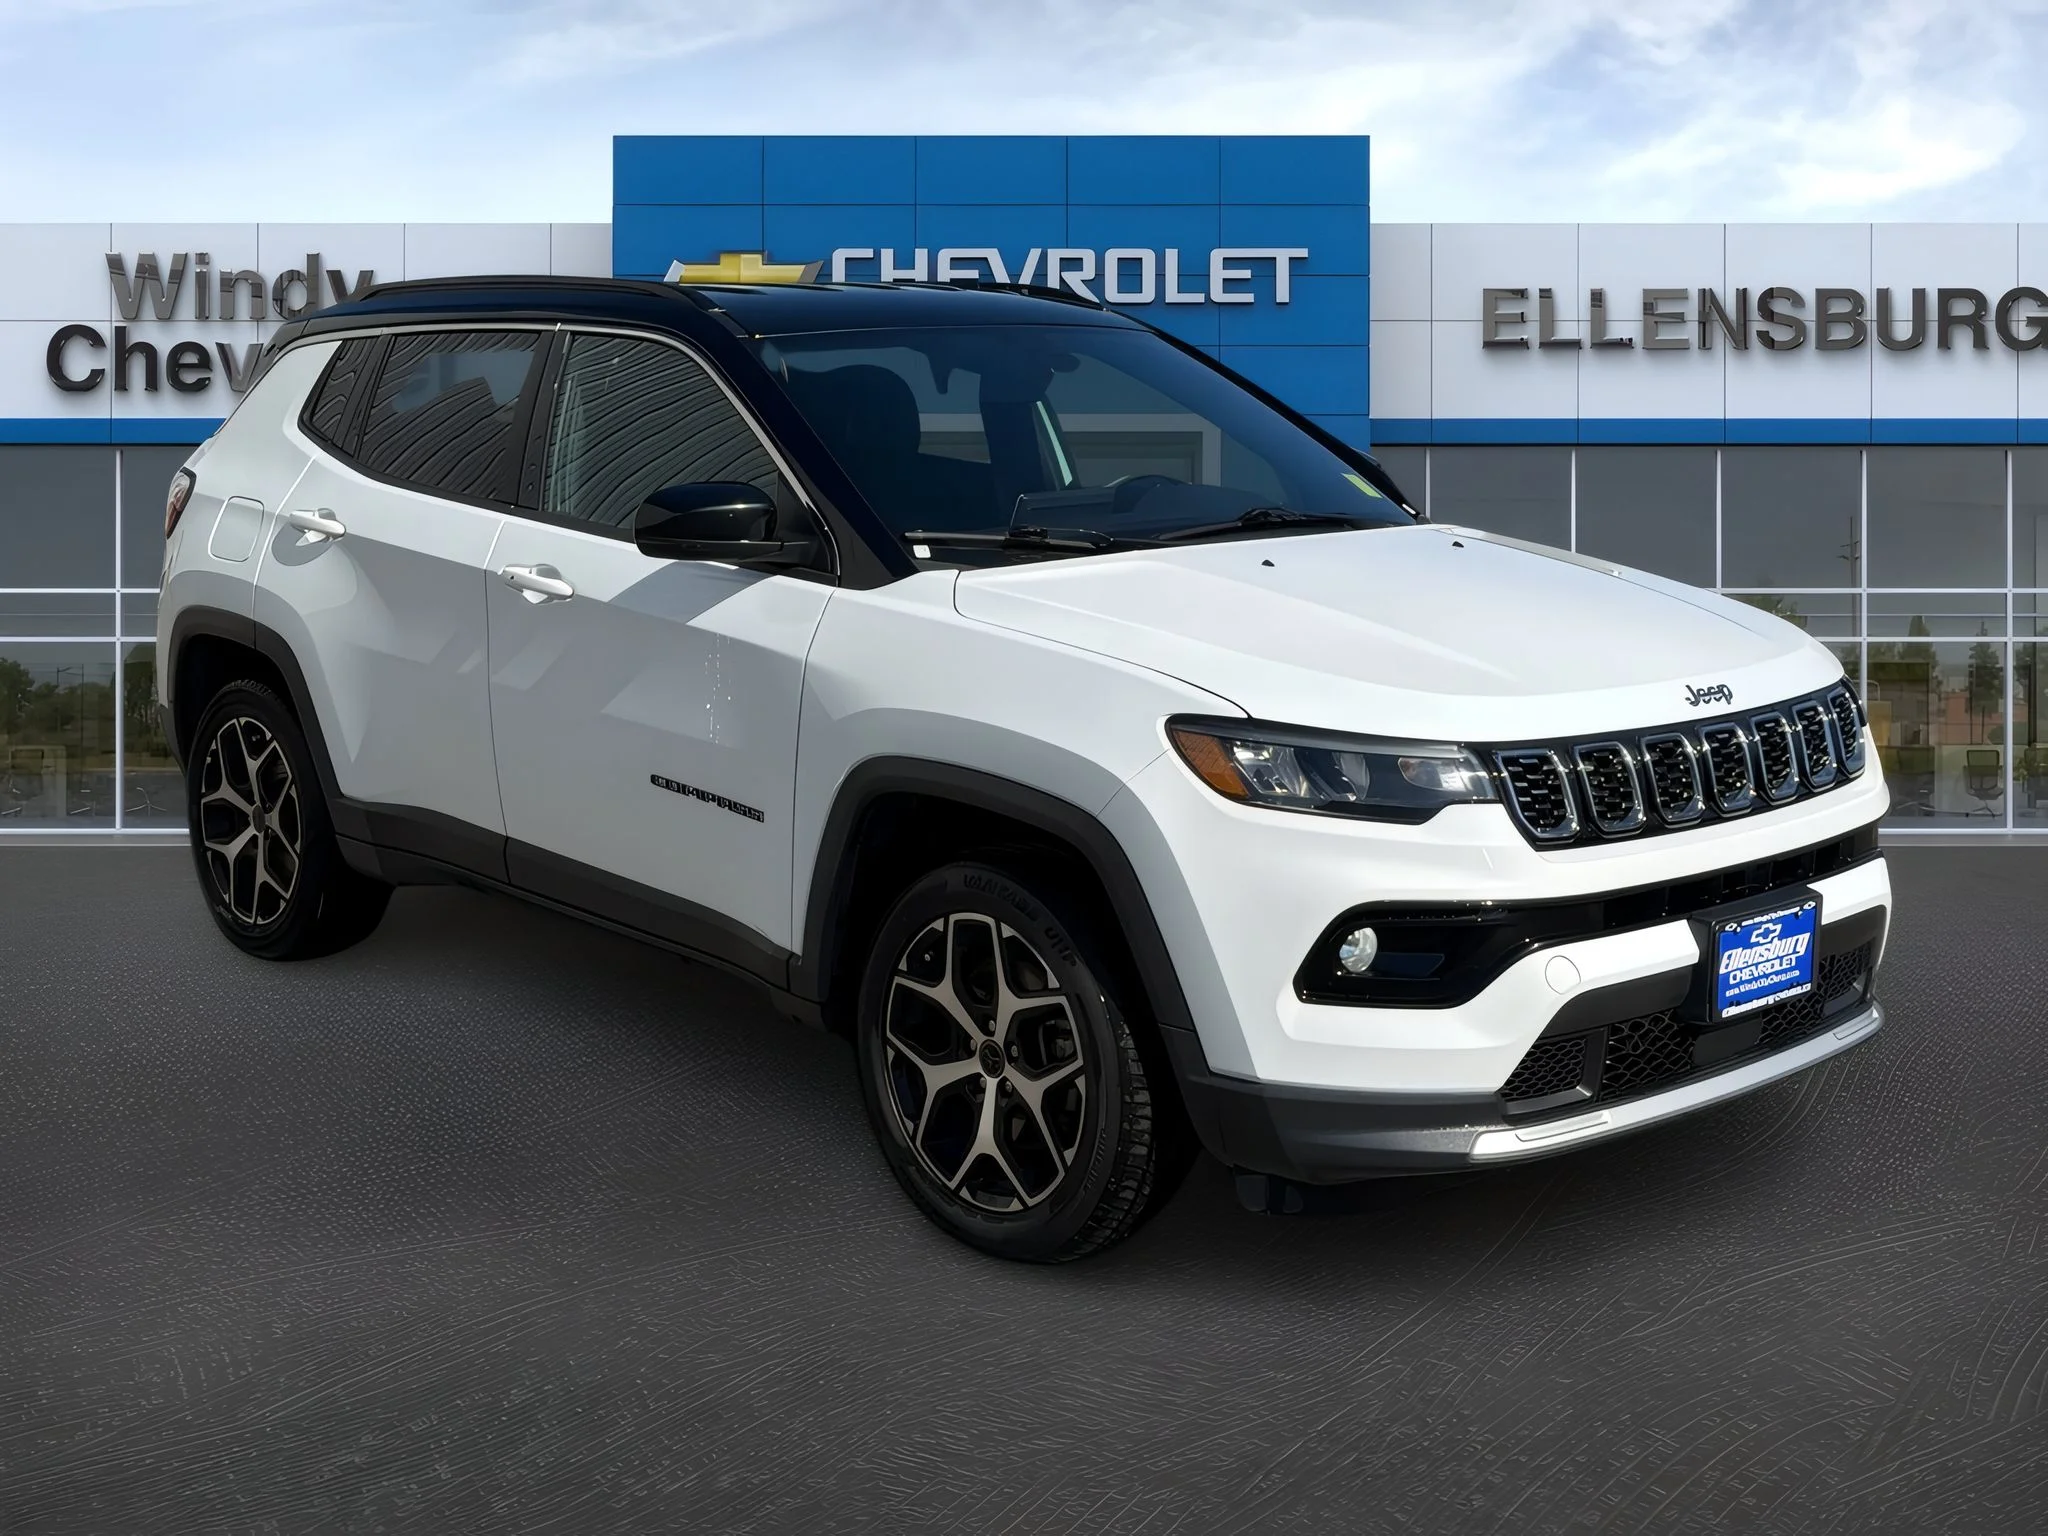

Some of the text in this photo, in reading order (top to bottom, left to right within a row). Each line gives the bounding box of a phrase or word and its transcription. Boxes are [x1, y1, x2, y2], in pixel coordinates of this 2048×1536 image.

[831, 248, 1309, 304] CHEVROLET
[1483, 287, 2048, 352] ELLENSBURG
[1685, 683, 1733, 706] Jeep
[1729, 955, 1797, 985] CHEVROLET
